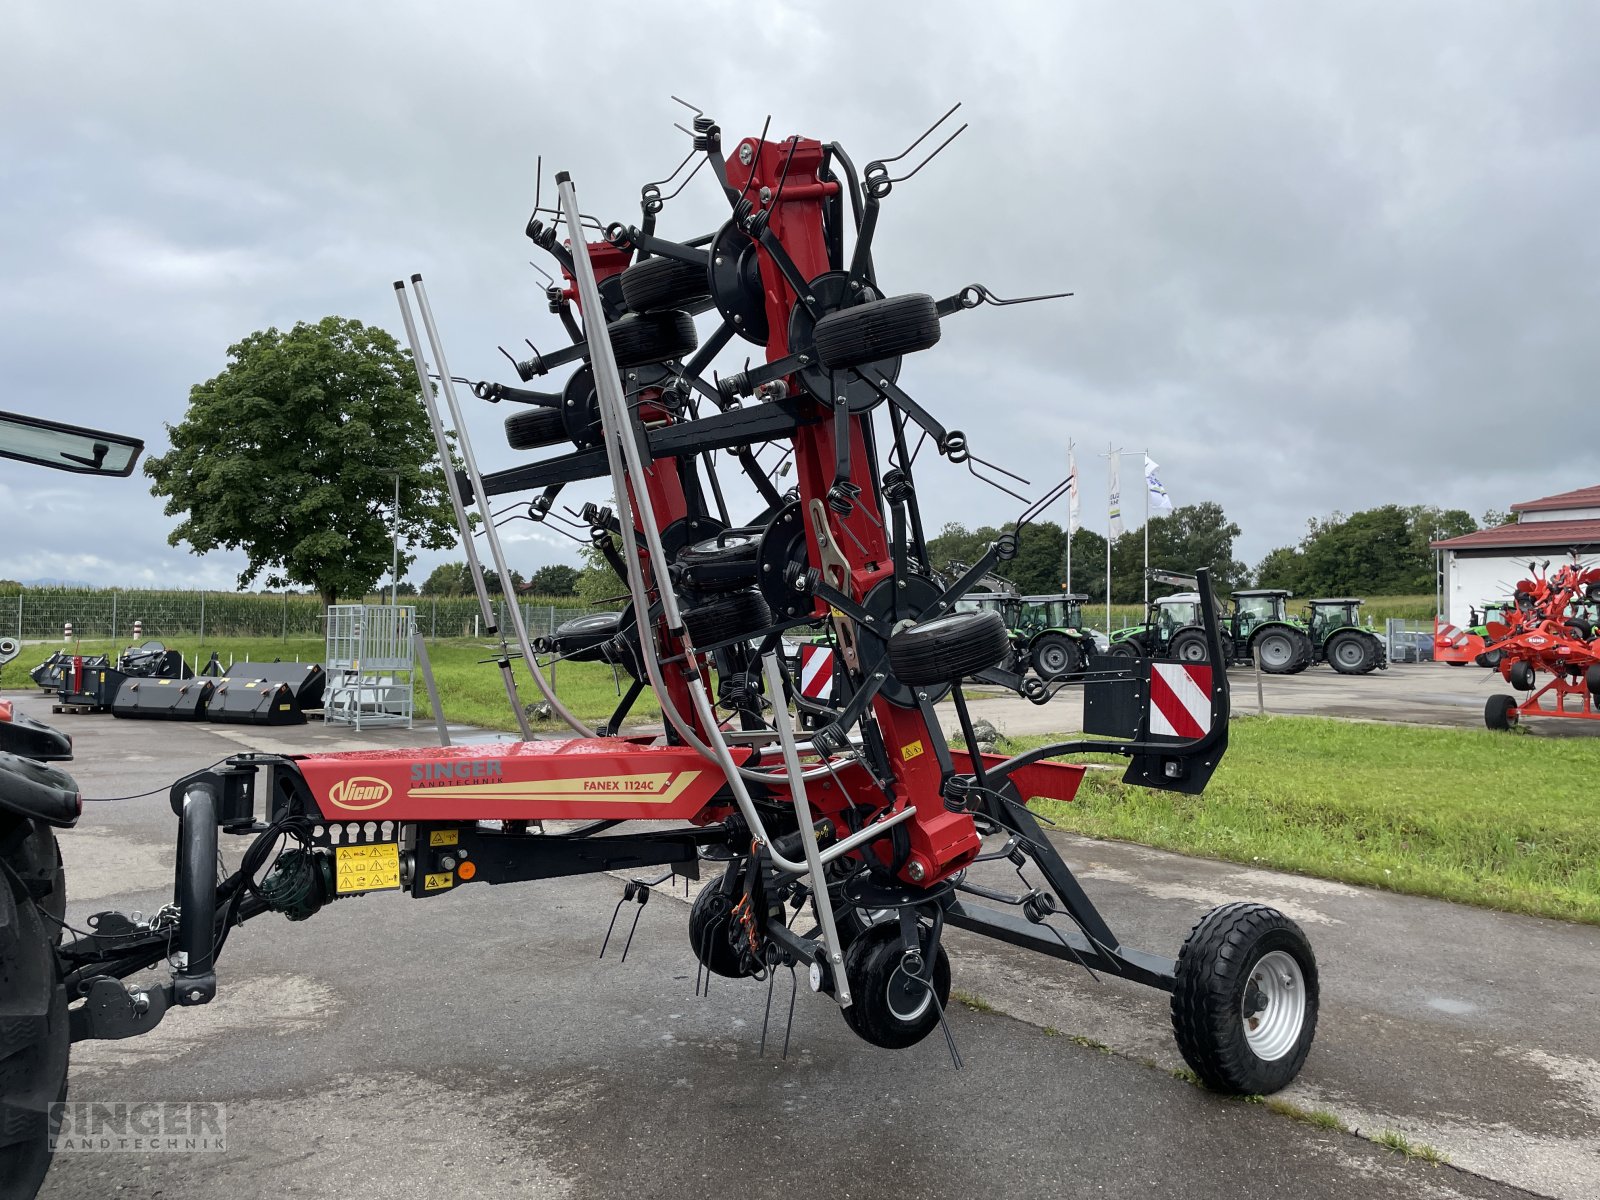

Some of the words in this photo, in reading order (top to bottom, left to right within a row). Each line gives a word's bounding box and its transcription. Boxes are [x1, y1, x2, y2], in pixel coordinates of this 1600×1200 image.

[411, 760, 503, 780] SINGER
[336, 779, 386, 802] Vicon
[411, 778, 504, 789] LANDTECHNIK
[583, 781, 620, 791] FANEX
[624, 781, 654, 790] 1124C
